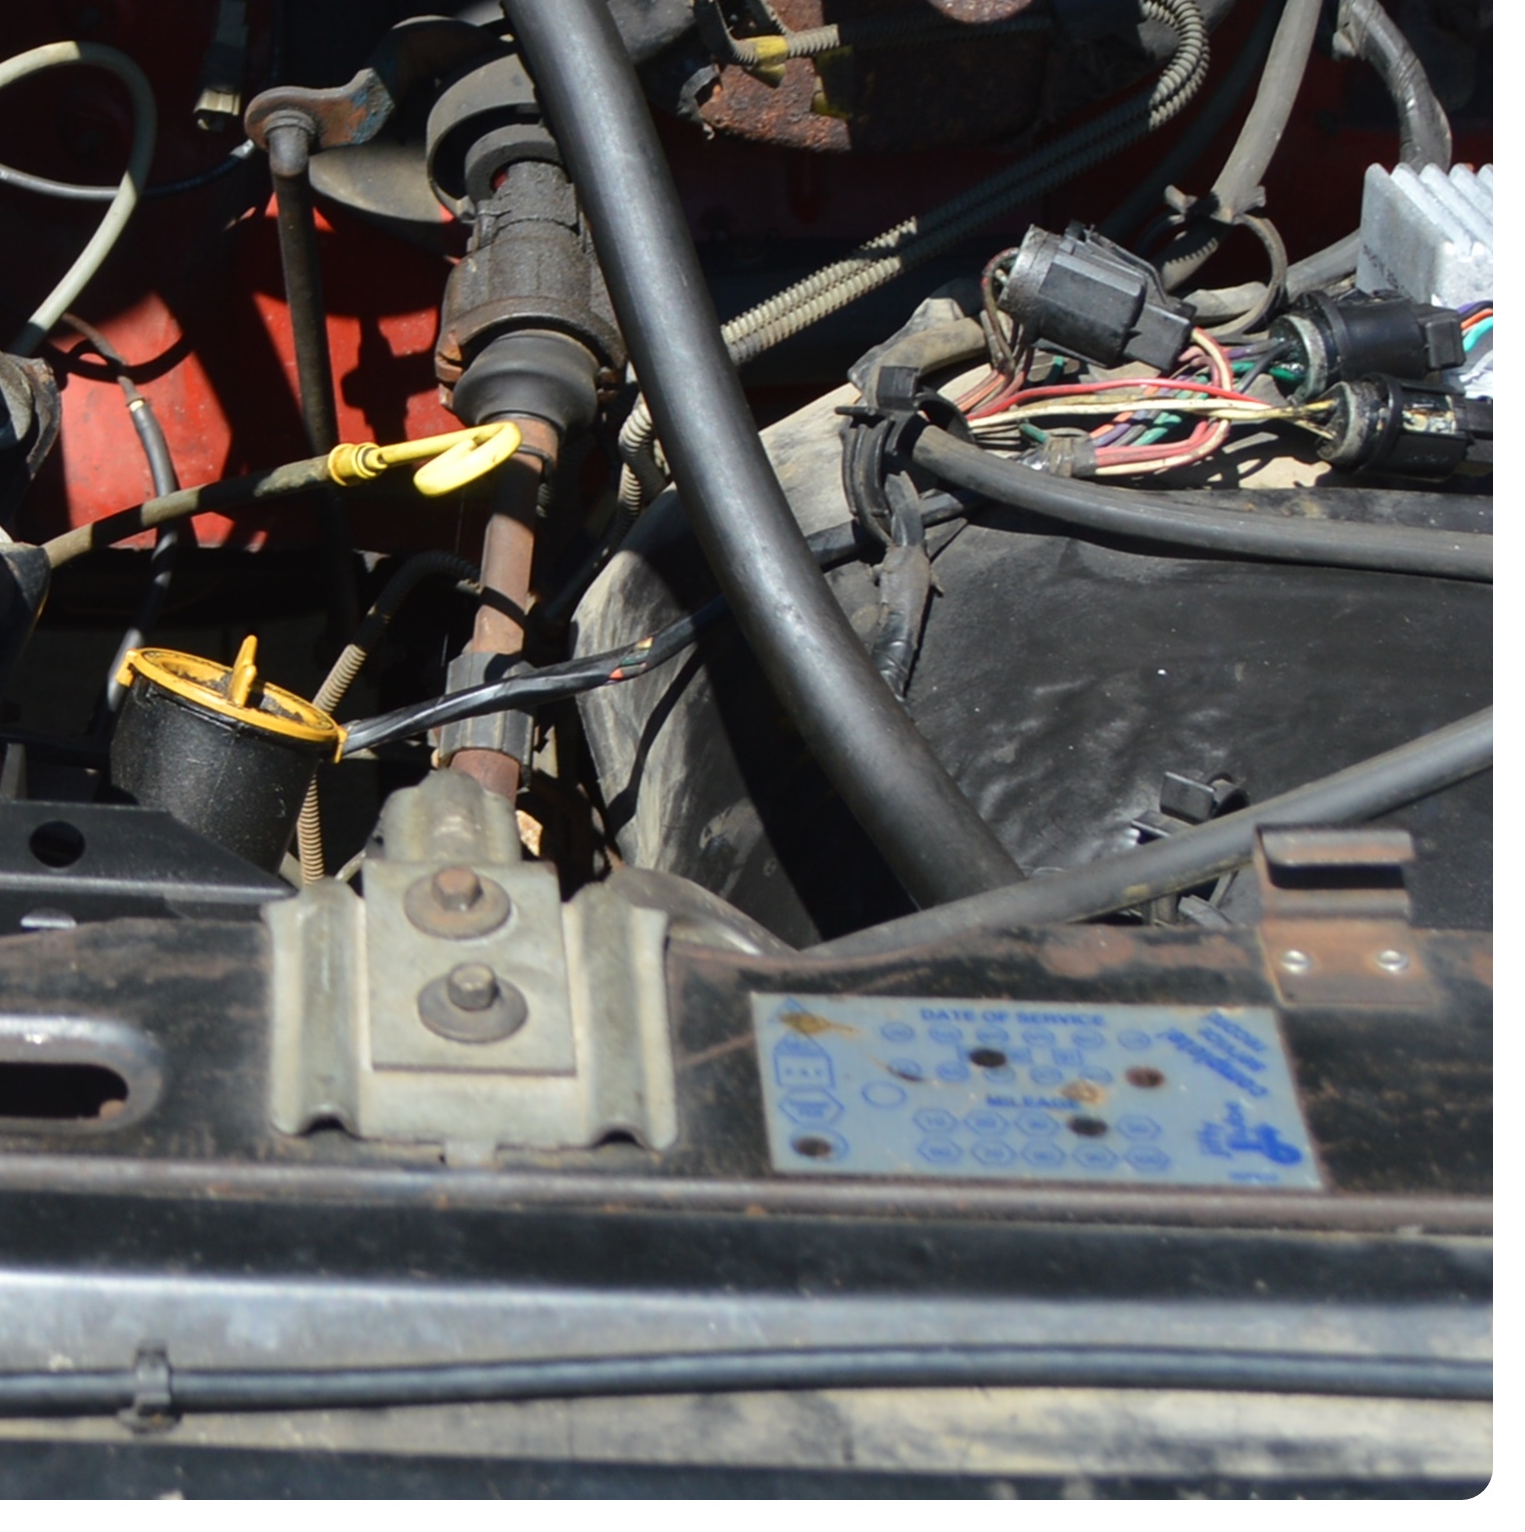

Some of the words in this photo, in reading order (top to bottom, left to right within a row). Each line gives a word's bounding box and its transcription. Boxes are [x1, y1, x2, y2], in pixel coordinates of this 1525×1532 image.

[921, 1008, 975, 1022] DATE
[982, 1009, 1009, 1023] OF
[1015, 1011, 1106, 1027] SERVICE
[986, 1094, 1082, 1112] MILEAGE
